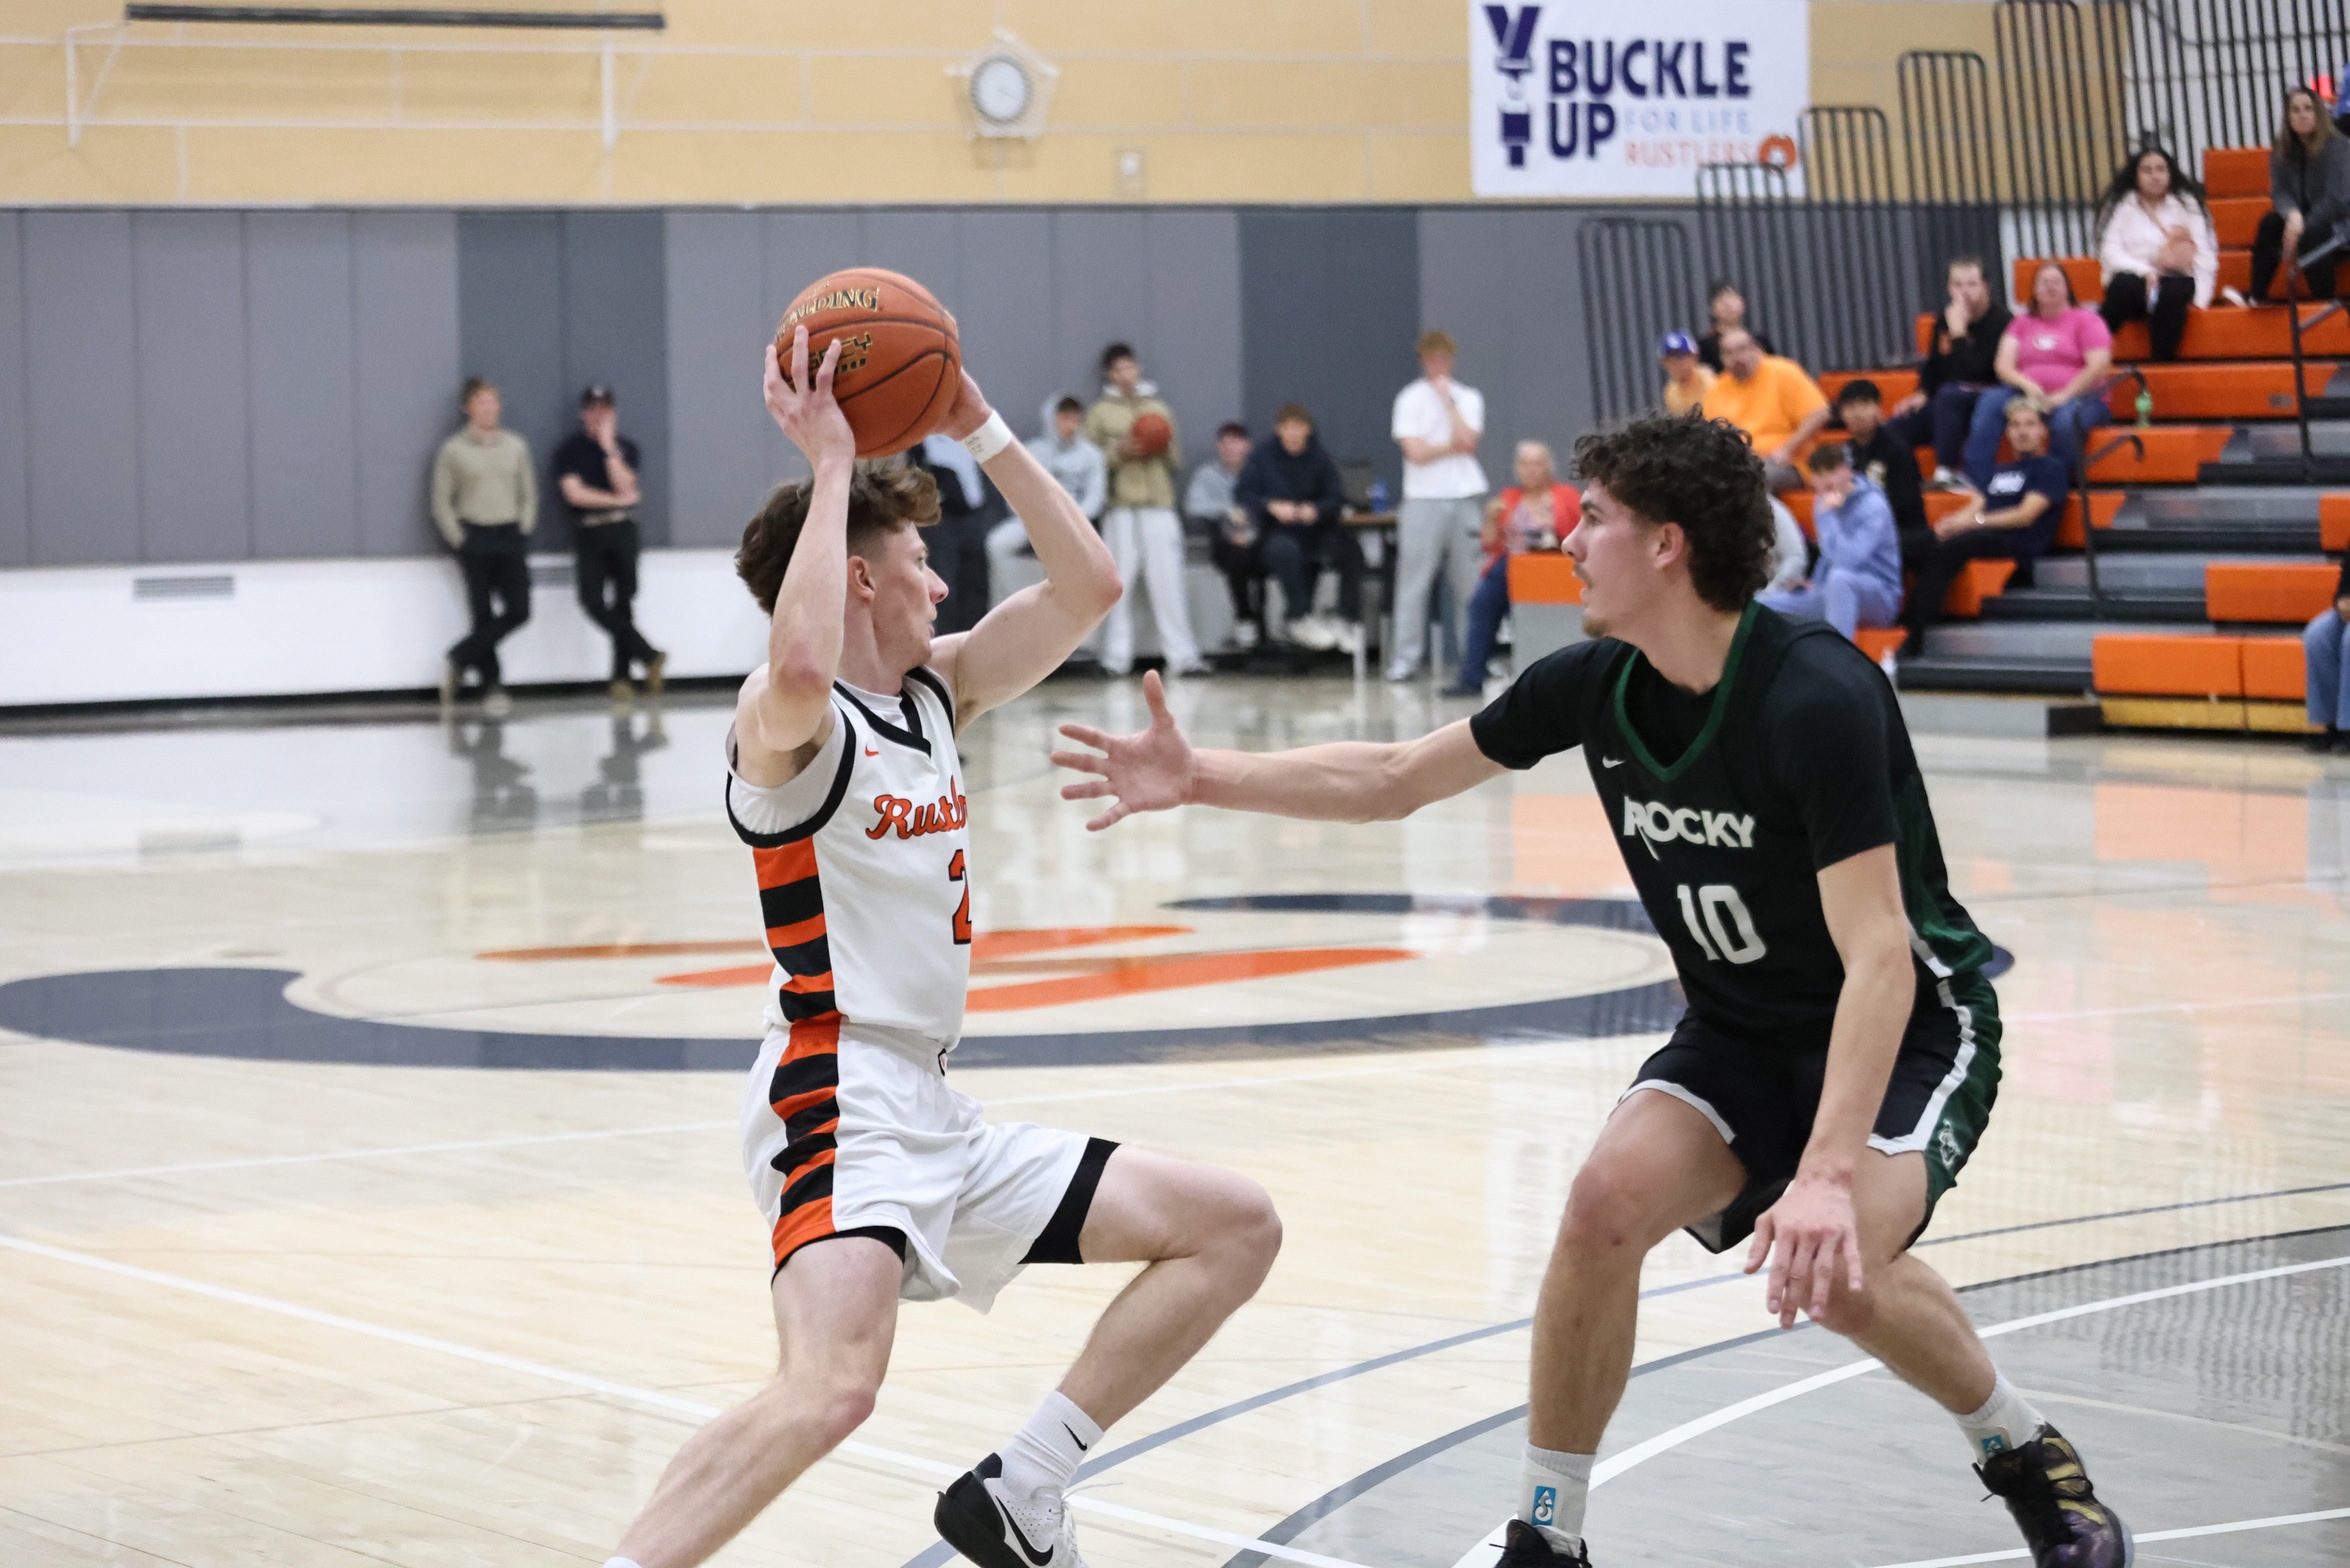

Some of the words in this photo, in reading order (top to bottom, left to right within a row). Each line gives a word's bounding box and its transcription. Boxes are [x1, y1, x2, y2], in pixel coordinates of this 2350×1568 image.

[1548, 39, 1750, 97] BUCKLE
[1549, 102, 1615, 159] UP
[1624, 107, 1680, 134] FOR
[1691, 107, 1751, 134] LIFE
[1624, 140, 1757, 168] RUSTLERS
[776, 287, 880, 338] ALDING
[1623, 796, 1755, 861] ROCKY
[1677, 885, 1766, 964] 10
